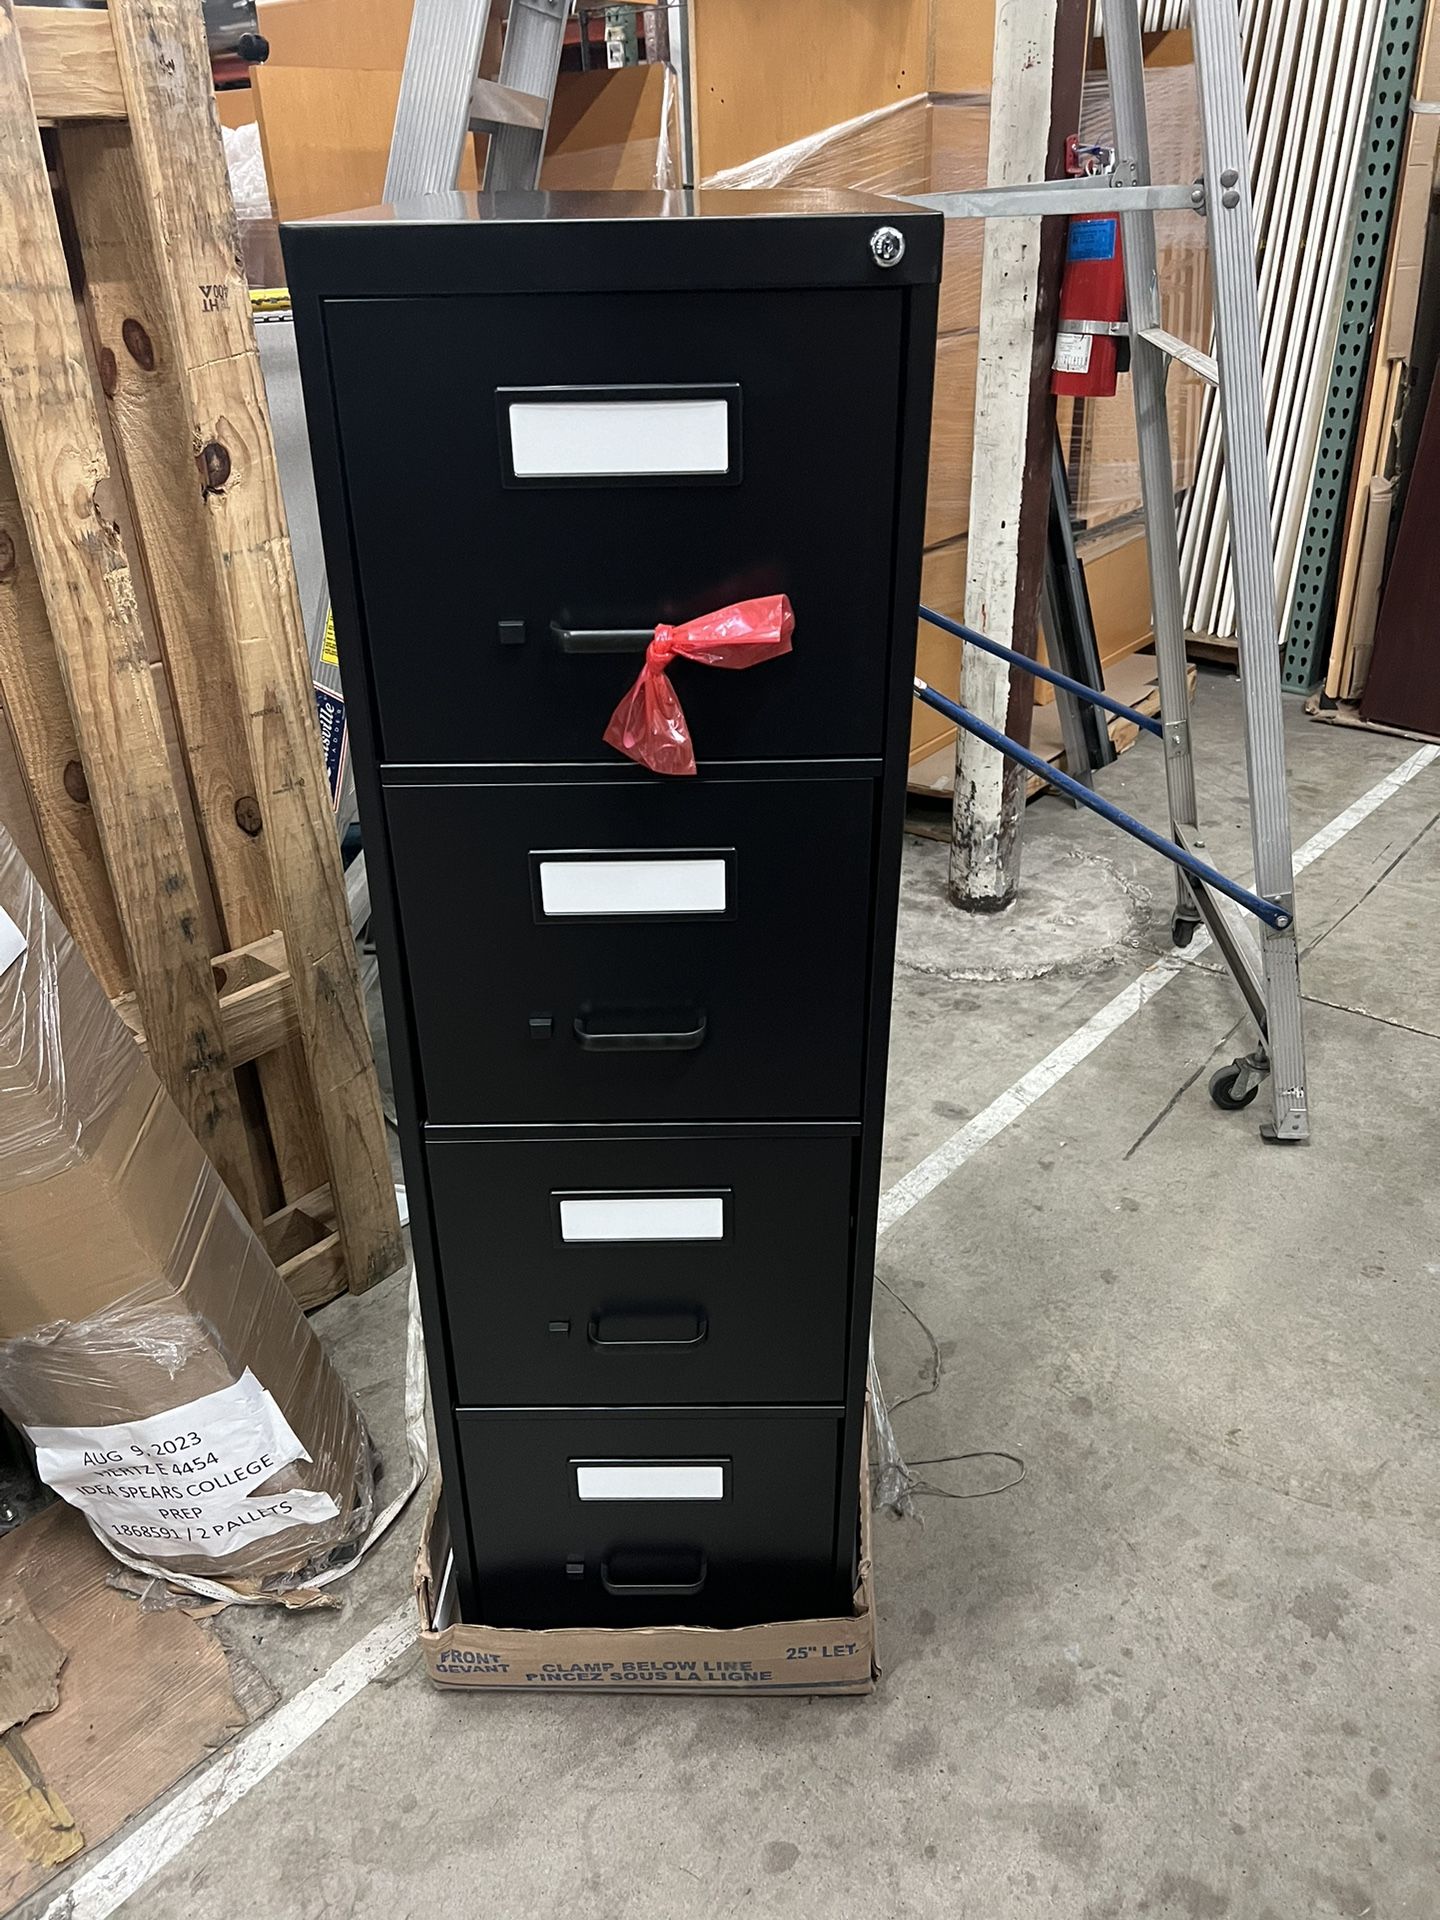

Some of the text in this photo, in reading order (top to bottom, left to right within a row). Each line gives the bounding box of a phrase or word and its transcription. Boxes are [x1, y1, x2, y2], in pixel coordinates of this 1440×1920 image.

[83, 1450, 123, 1467] AUG
[155, 1463, 169, 1476] E
[172, 1452, 219, 1476] 4454
[76, 1453, 274, 1499] IDEA SPEARS COLLEGE
[111, 1524, 183, 1540] 1868591
[196, 1527, 211, 1540] 2
[212, 1500, 293, 1537] PALLETS
[158, 1507, 203, 1520] PREP
[440, 1650, 500, 1664] FRONT
[786, 1646, 817, 1660] 25"
[436, 1664, 510, 1674] DEVANT
[542, 1661, 753, 1673] CLAMP BELOW LINE
[525, 1671, 773, 1682] PINCEZ SOUS LA LIGNE
